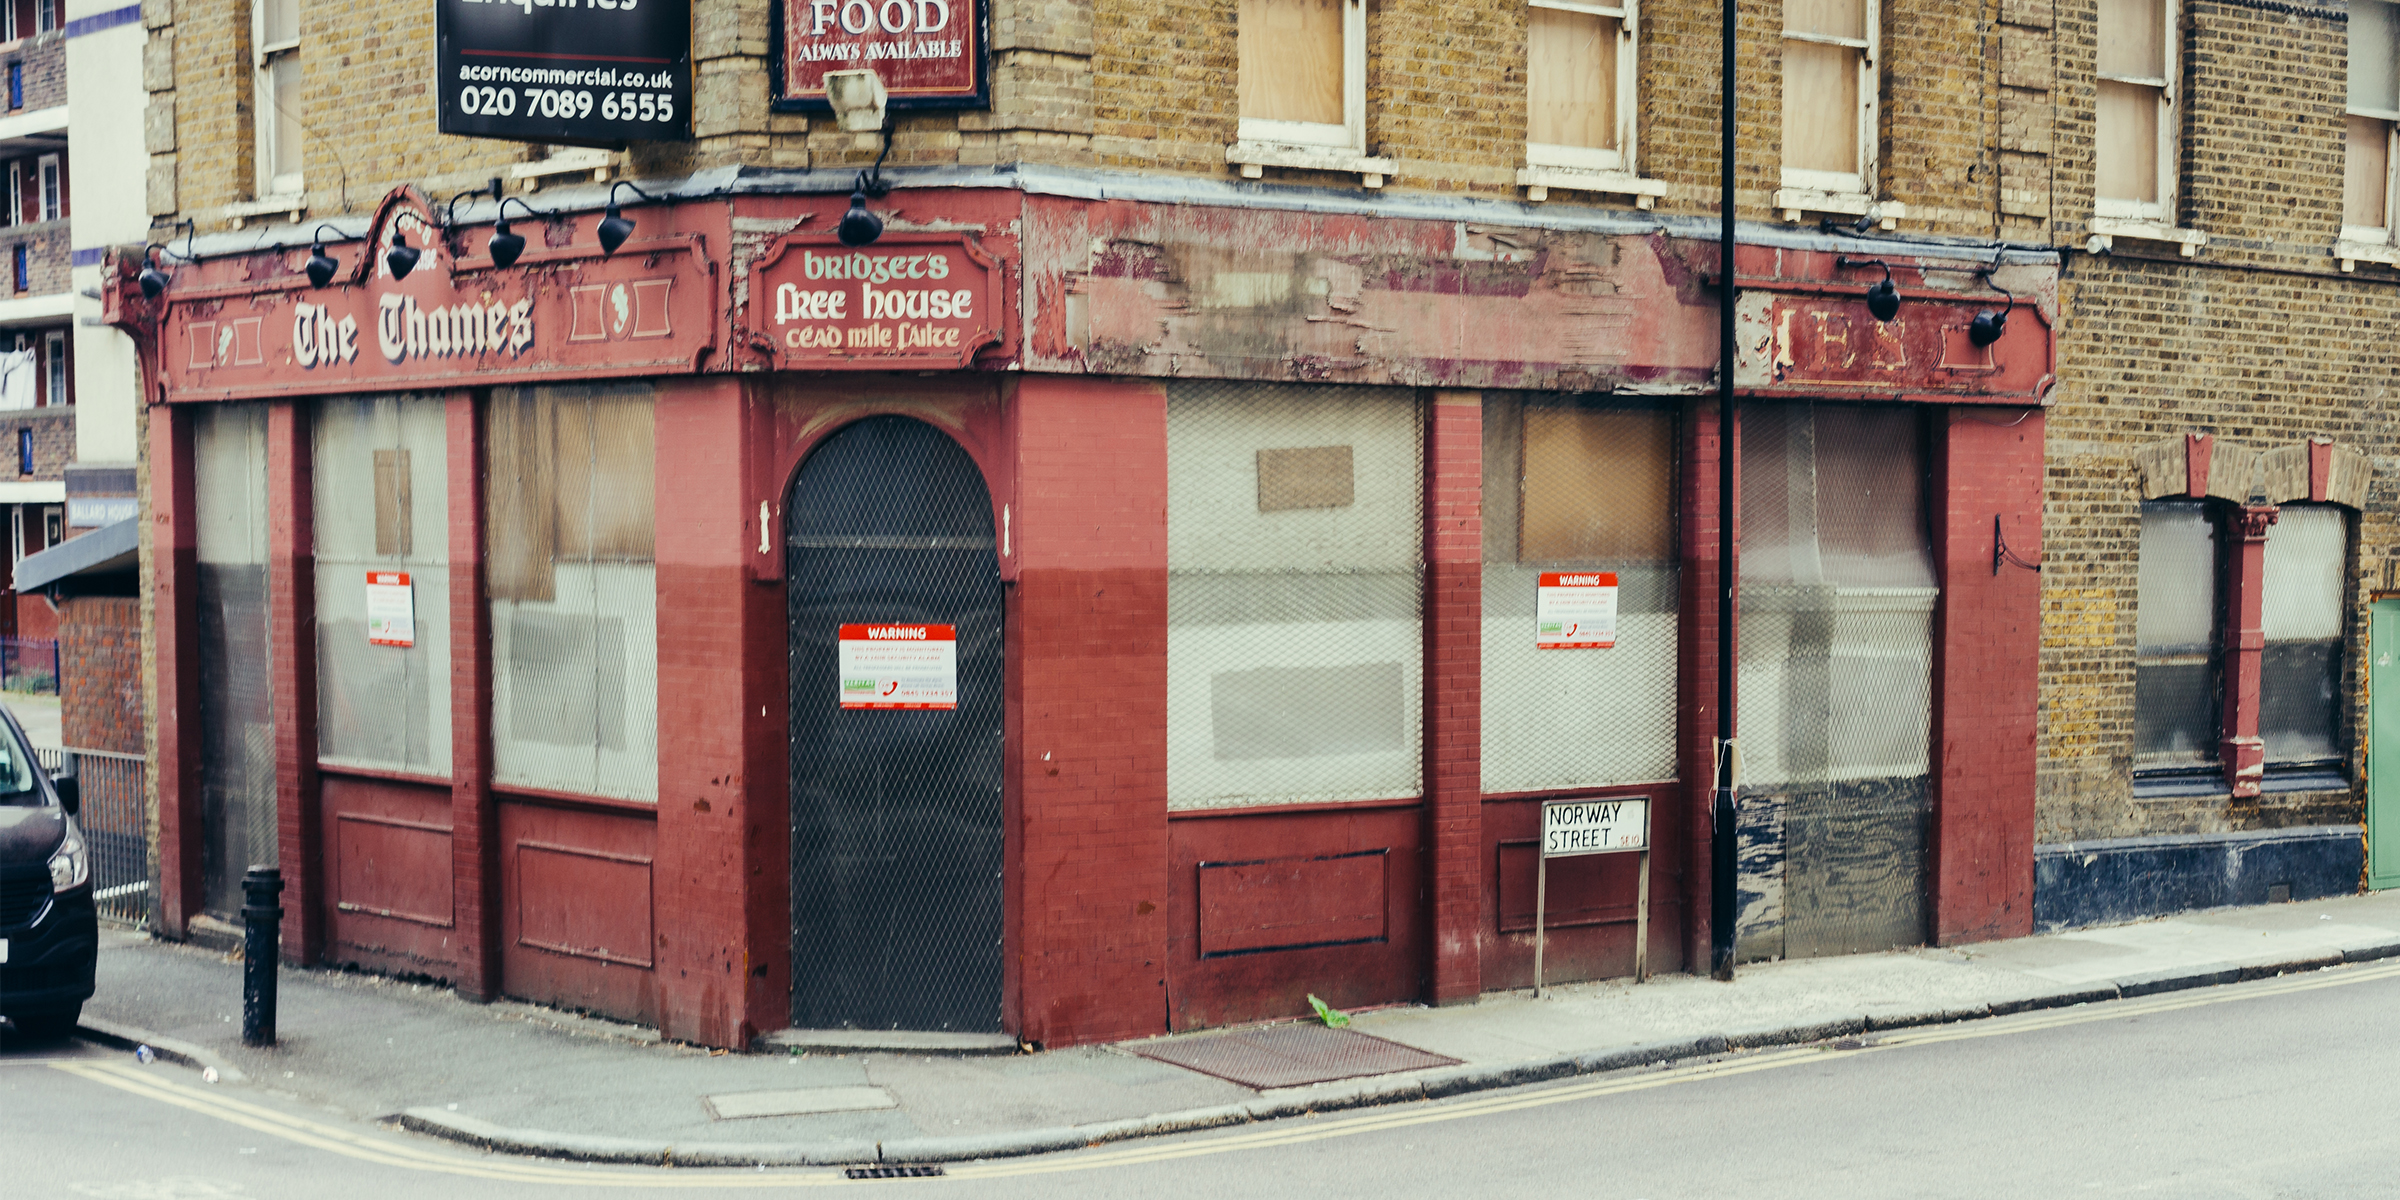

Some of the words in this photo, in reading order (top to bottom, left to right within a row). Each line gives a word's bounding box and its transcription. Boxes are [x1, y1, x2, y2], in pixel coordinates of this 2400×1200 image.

[811, 0, 949, 35] FOOD
[799, 43, 861, 61] ALWAYS
[864, 40, 962, 60] AVAILABLE
[459, 65, 673, 89] acorncommercial.co.uk
[460, 85, 516, 116] 020
[524, 89, 593, 119] 7089
[601, 92, 674, 122] 6555
[293, 302, 358, 368] The
[378, 292, 534, 365] Thames
[1559, 575, 1600, 586] WARNING
[868, 627, 926, 640] WARNING
[1550, 804, 1622, 825] NORWAY
[1550, 828, 1611, 850] STREET
